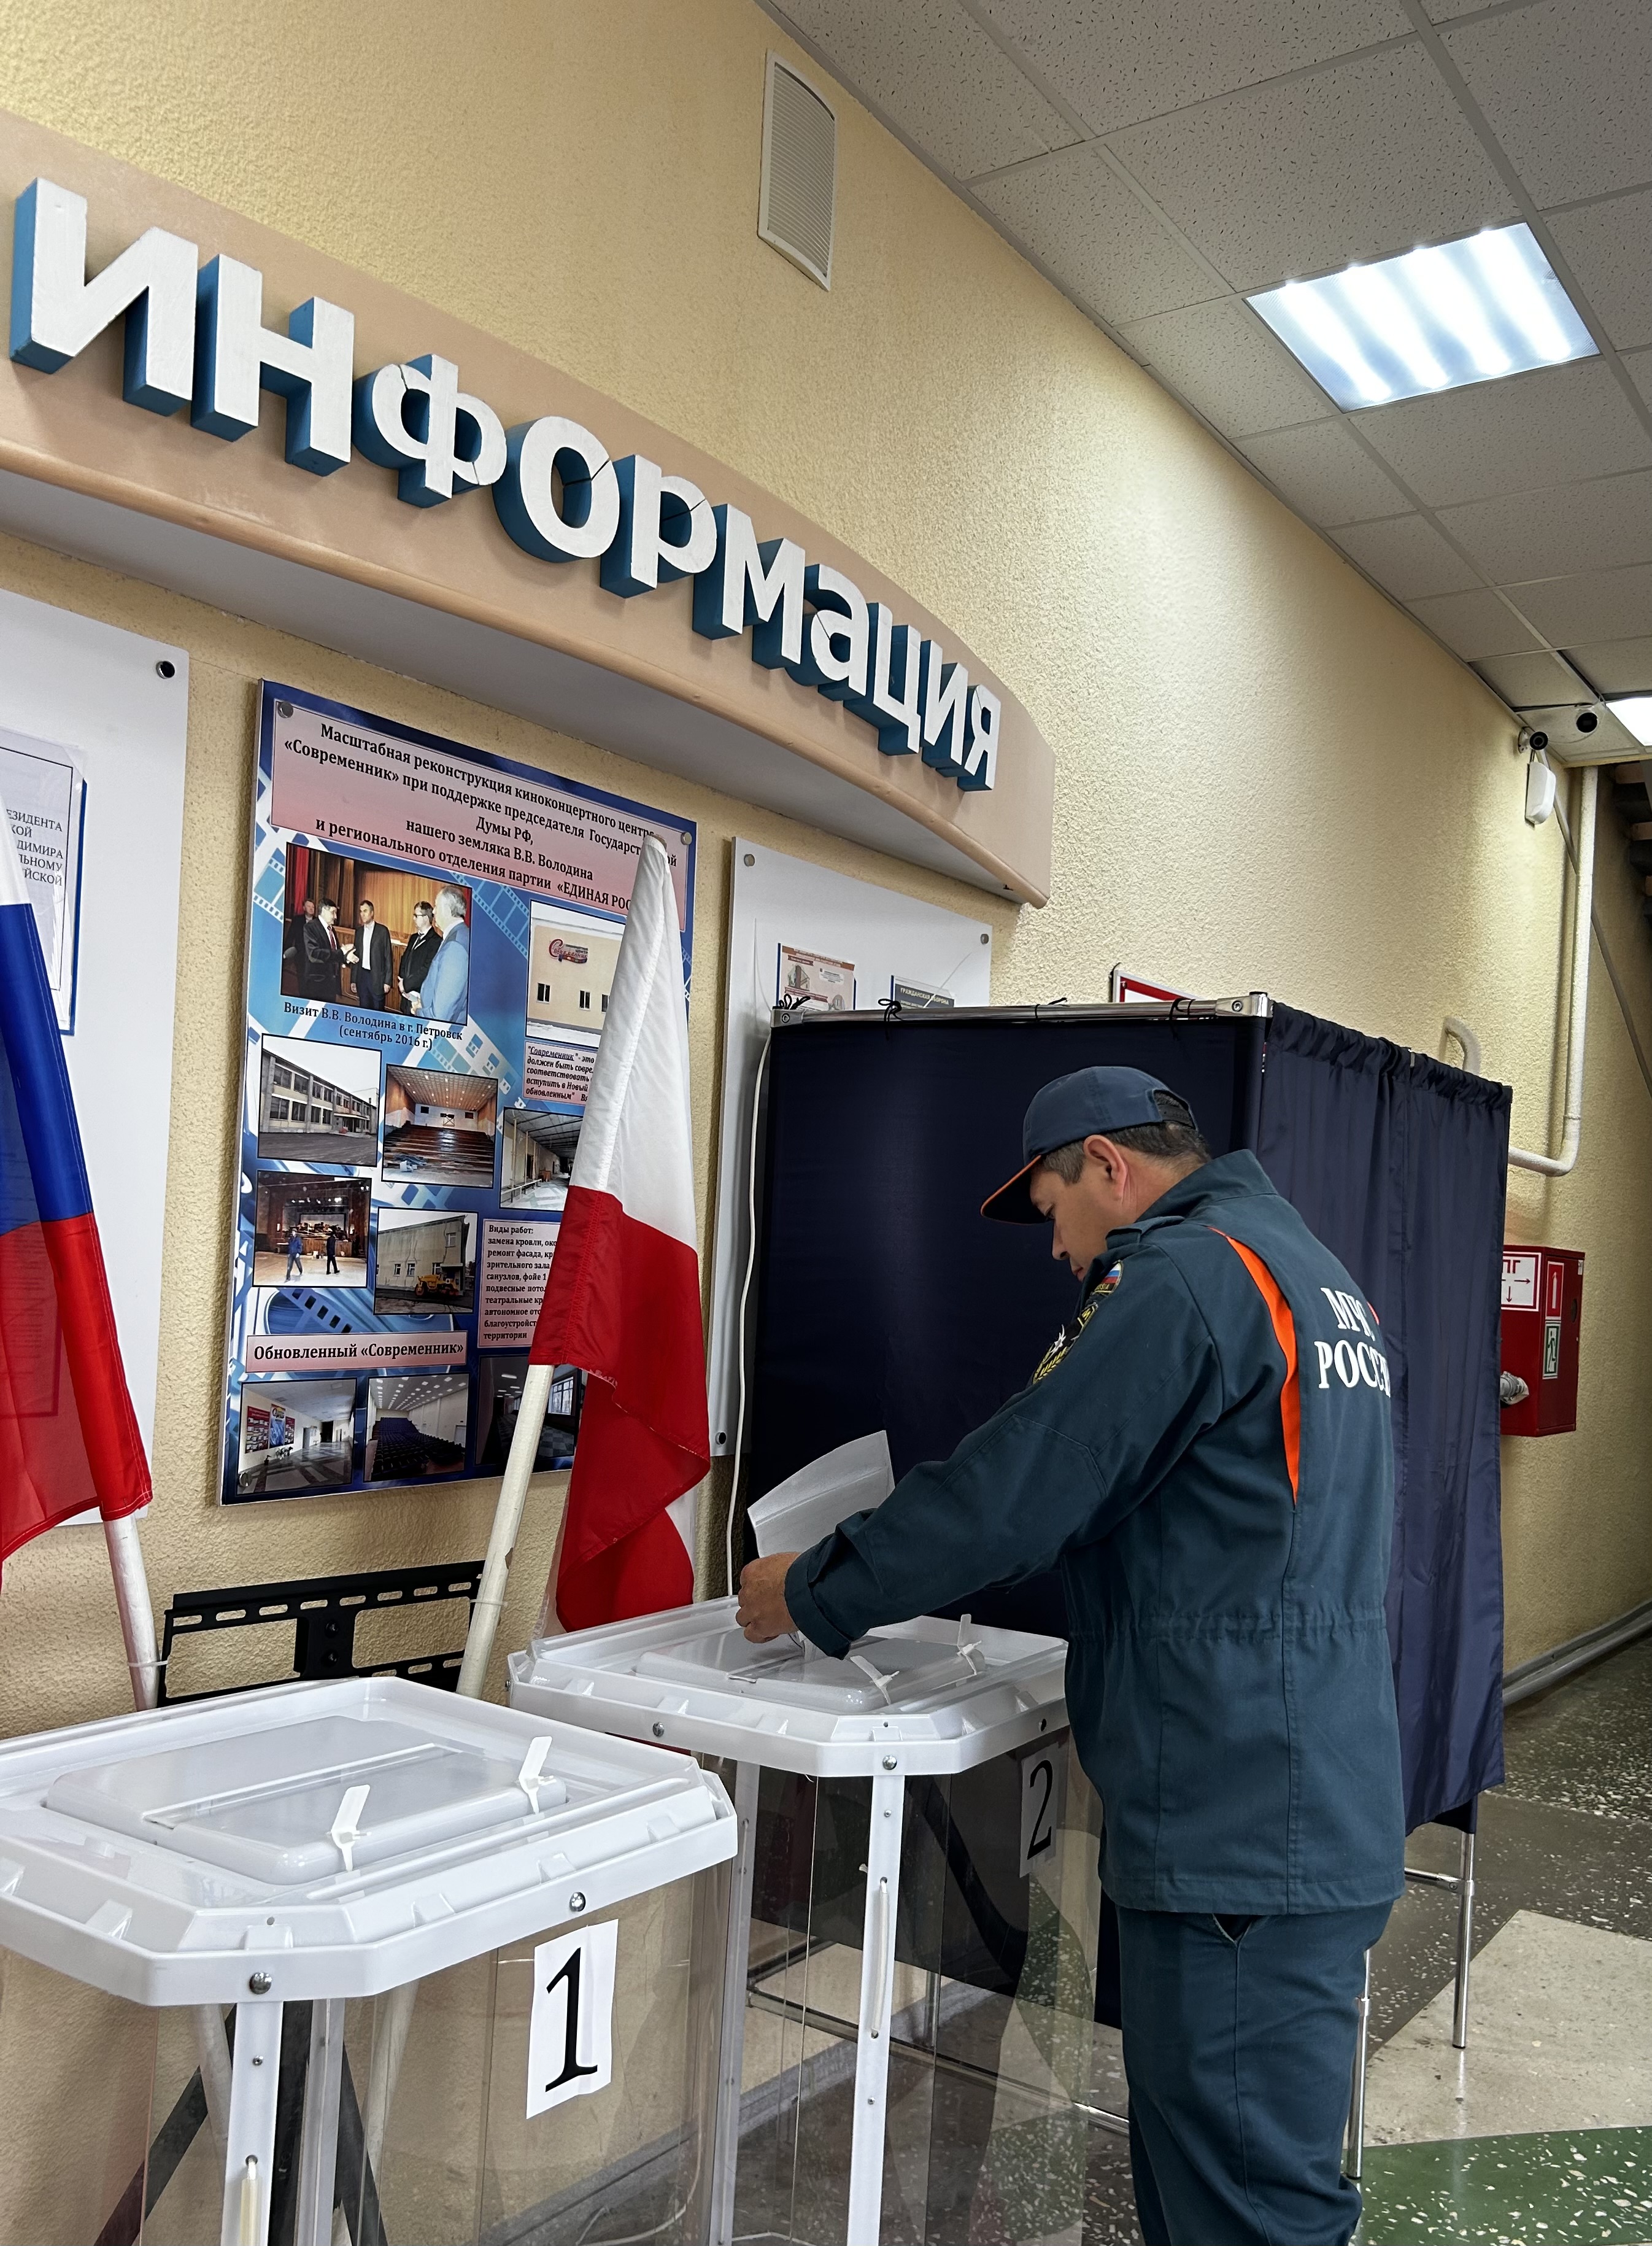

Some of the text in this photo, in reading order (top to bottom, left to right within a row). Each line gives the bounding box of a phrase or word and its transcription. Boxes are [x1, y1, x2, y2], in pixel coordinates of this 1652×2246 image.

[285, 739, 399, 781] «Современник»
[403, 775, 428, 791] при
[431, 783, 501, 813] поддержке
[504, 805, 584, 838] председателя
[321, 723, 654, 837] Масштабная реконструкция киноконцертного центр
[6, 808, 63, 832] ЕЗИДЕНТА
[11, 824, 32, 837] КОЙ
[476, 816, 533, 845] Думы РФ,
[17, 840, 63, 859] ДИМИРА
[406, 820, 593, 880] нашего земляка В.В. Володина
[18, 854, 63, 872] ЛЬНОМУ
[315, 819, 631, 911] и регионального отделения партии «ЕДИНАЯ РОС
[23, 867, 62, 886] ЙСКОЙ
[284, 1002, 318, 1017] Визит
[322, 1007, 341, 1021] В.В.
[344, 1012, 396, 1030] Володина
[407, 1024, 414, 1033] г.
[416, 1023, 463, 1040] Петровск
[339, 1024, 432, 1050] (сентябрь 2016 г.)
[527, 1056, 593, 1074] должен быть совре
[527, 1067, 589, 1082] соответствовать
[526, 1077, 560, 1088] вступить
[567, 1082, 588, 1092] Новый
[488, 1225, 533, 1235] Виды работ:
[516, 1249, 542, 1258] фасада,
[487, 1261, 533, 1270] зрительного
[487, 1273, 522, 1282] санузлов,
[523, 1272, 541, 1282] фойе
[484, 1319, 537, 1329] благоустройст
[254, 1342, 463, 1360] Обновленный «Современник»
[1027, 1759, 1053, 1861] 2
[546, 1946, 598, 2093] 1
